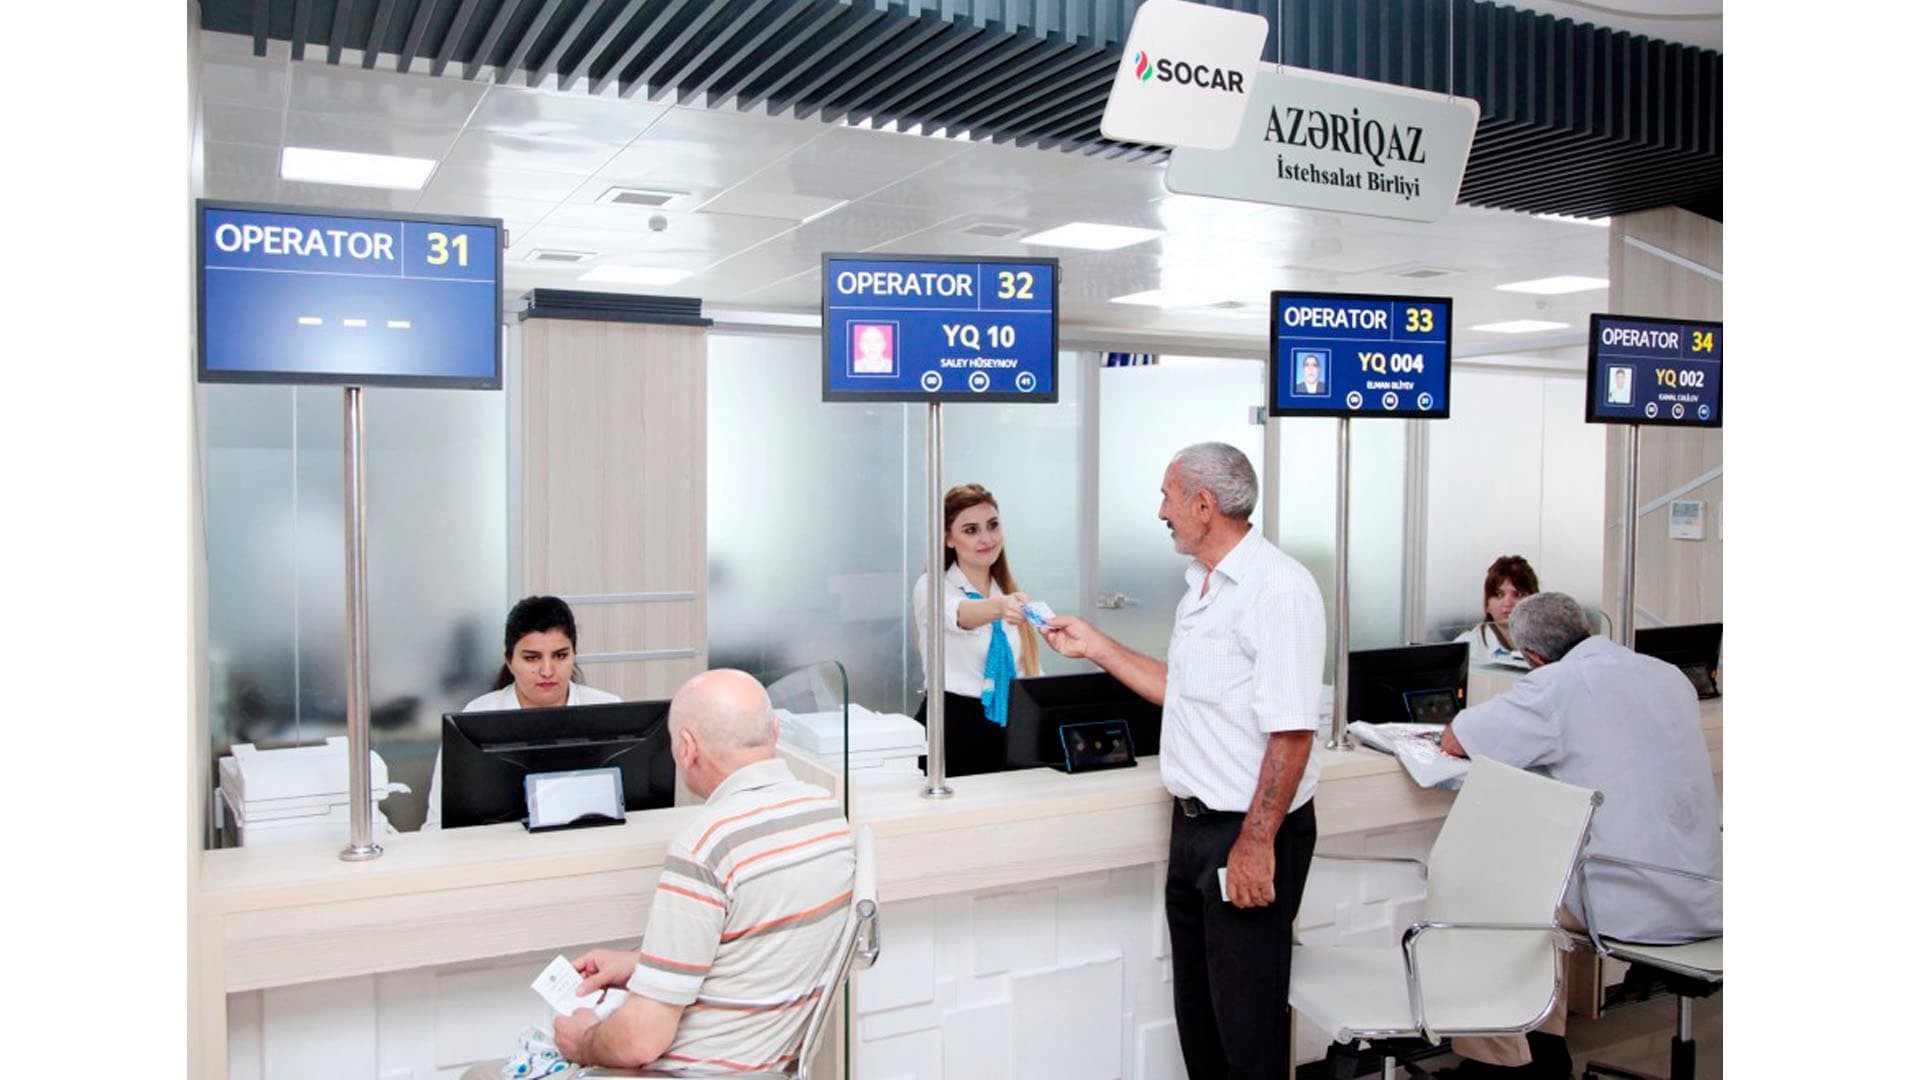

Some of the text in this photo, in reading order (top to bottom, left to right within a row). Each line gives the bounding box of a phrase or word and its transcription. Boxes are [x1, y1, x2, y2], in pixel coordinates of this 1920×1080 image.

[1156, 58, 1245, 94] SOCAR
[1263, 104, 1426, 167] AZƏRİQAZ
[1276, 154, 1421, 201] İstehsalat Birliyi
[215, 223, 469, 267] OPERATOR 31
[837, 271, 1034, 299] OPERATOR 32
[1284, 306, 1434, 333] OPERATOR 33
[942, 324, 1016, 350] YQ 10
[1601, 327, 1714, 353] OPERATOR 34
[1358, 352, 1424, 375] YQ 004
[1655, 368, 1705, 388] YQ 002
